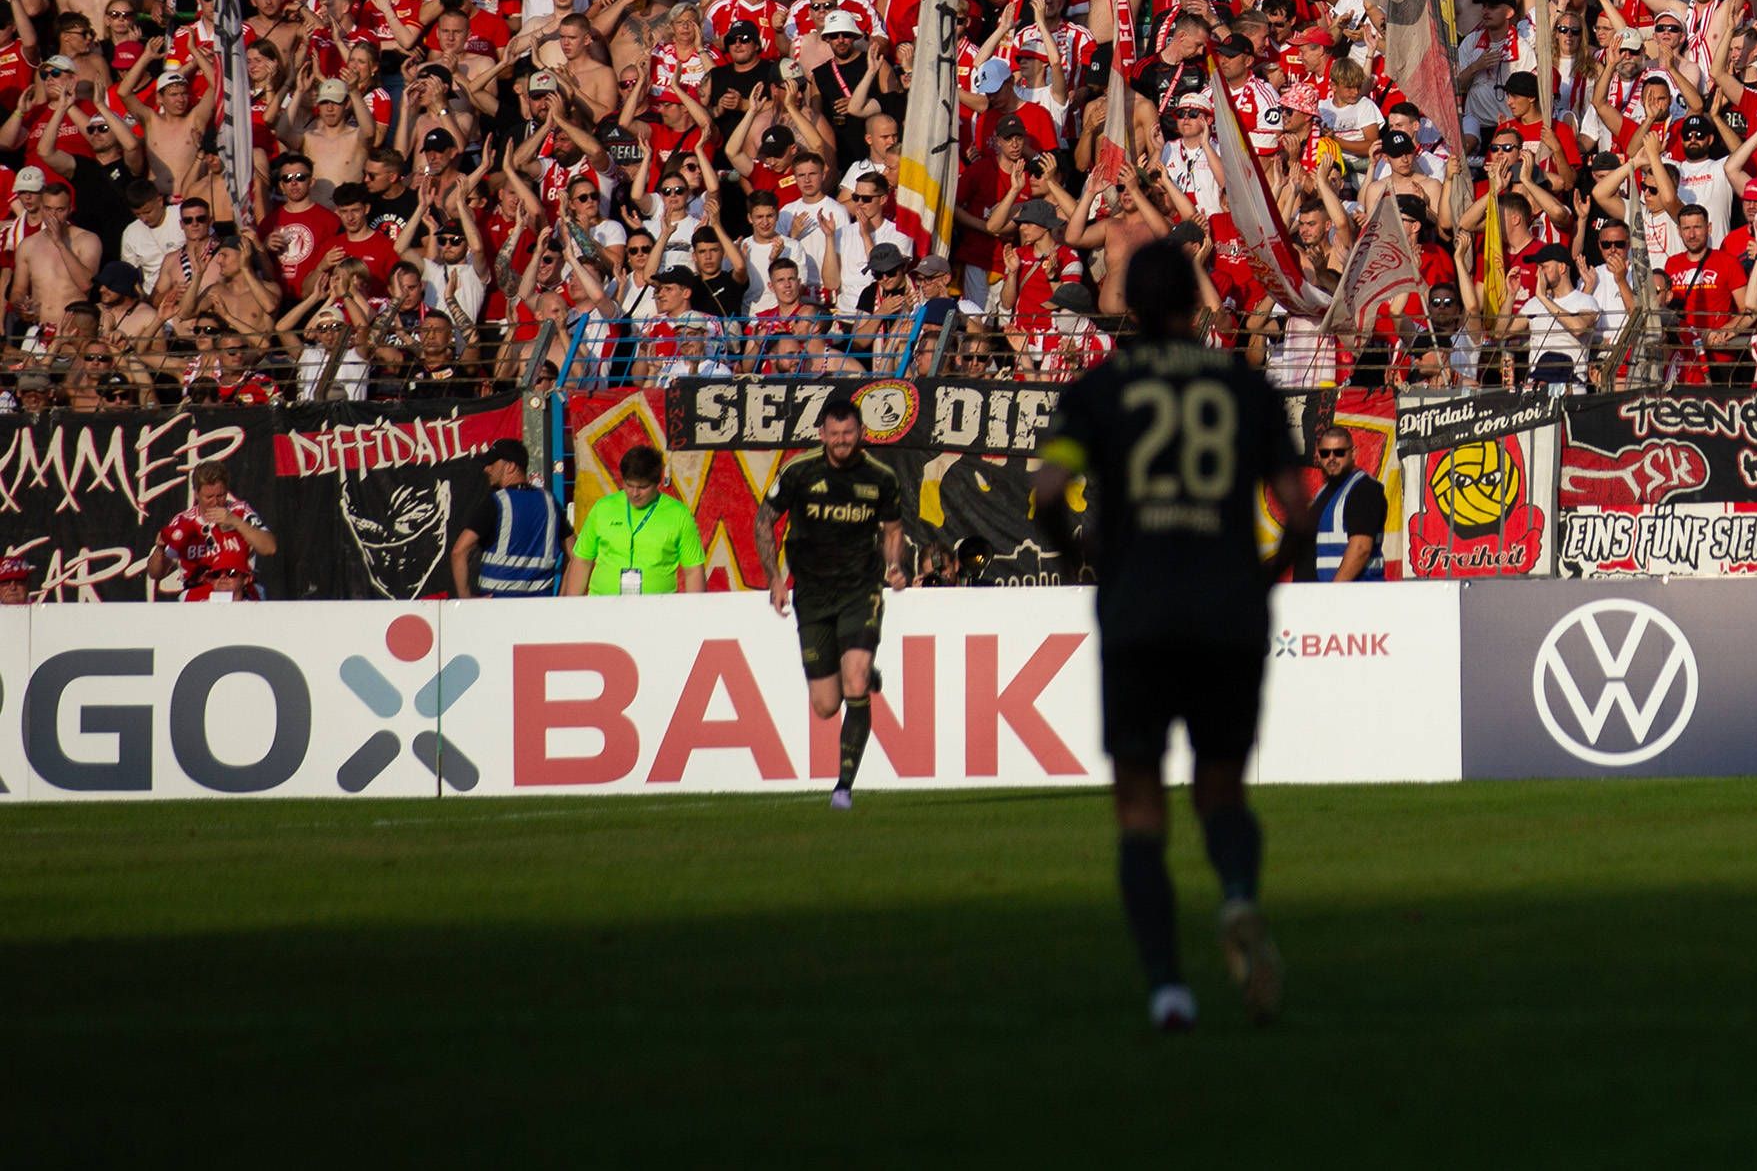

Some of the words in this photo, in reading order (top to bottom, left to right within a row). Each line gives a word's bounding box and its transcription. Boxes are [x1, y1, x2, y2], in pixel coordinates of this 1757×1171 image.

[1266, 112, 1280, 122] JD
[610, 145, 645, 160] BERLI
[1400, 402, 1475, 437] Diffidati
[1474, 416, 1510, 435] con
[1511, 403, 1543, 425] noi
[1121, 380, 1237, 502] 28
[1565, 514, 1635, 561] EINS
[1635, 504, 1708, 570] FÜNF
[1420, 541, 1528, 571] Freiheit
[1301, 632, 1390, 658] BANK
[0, 643, 312, 795] GO
[512, 632, 1089, 788] BANK
